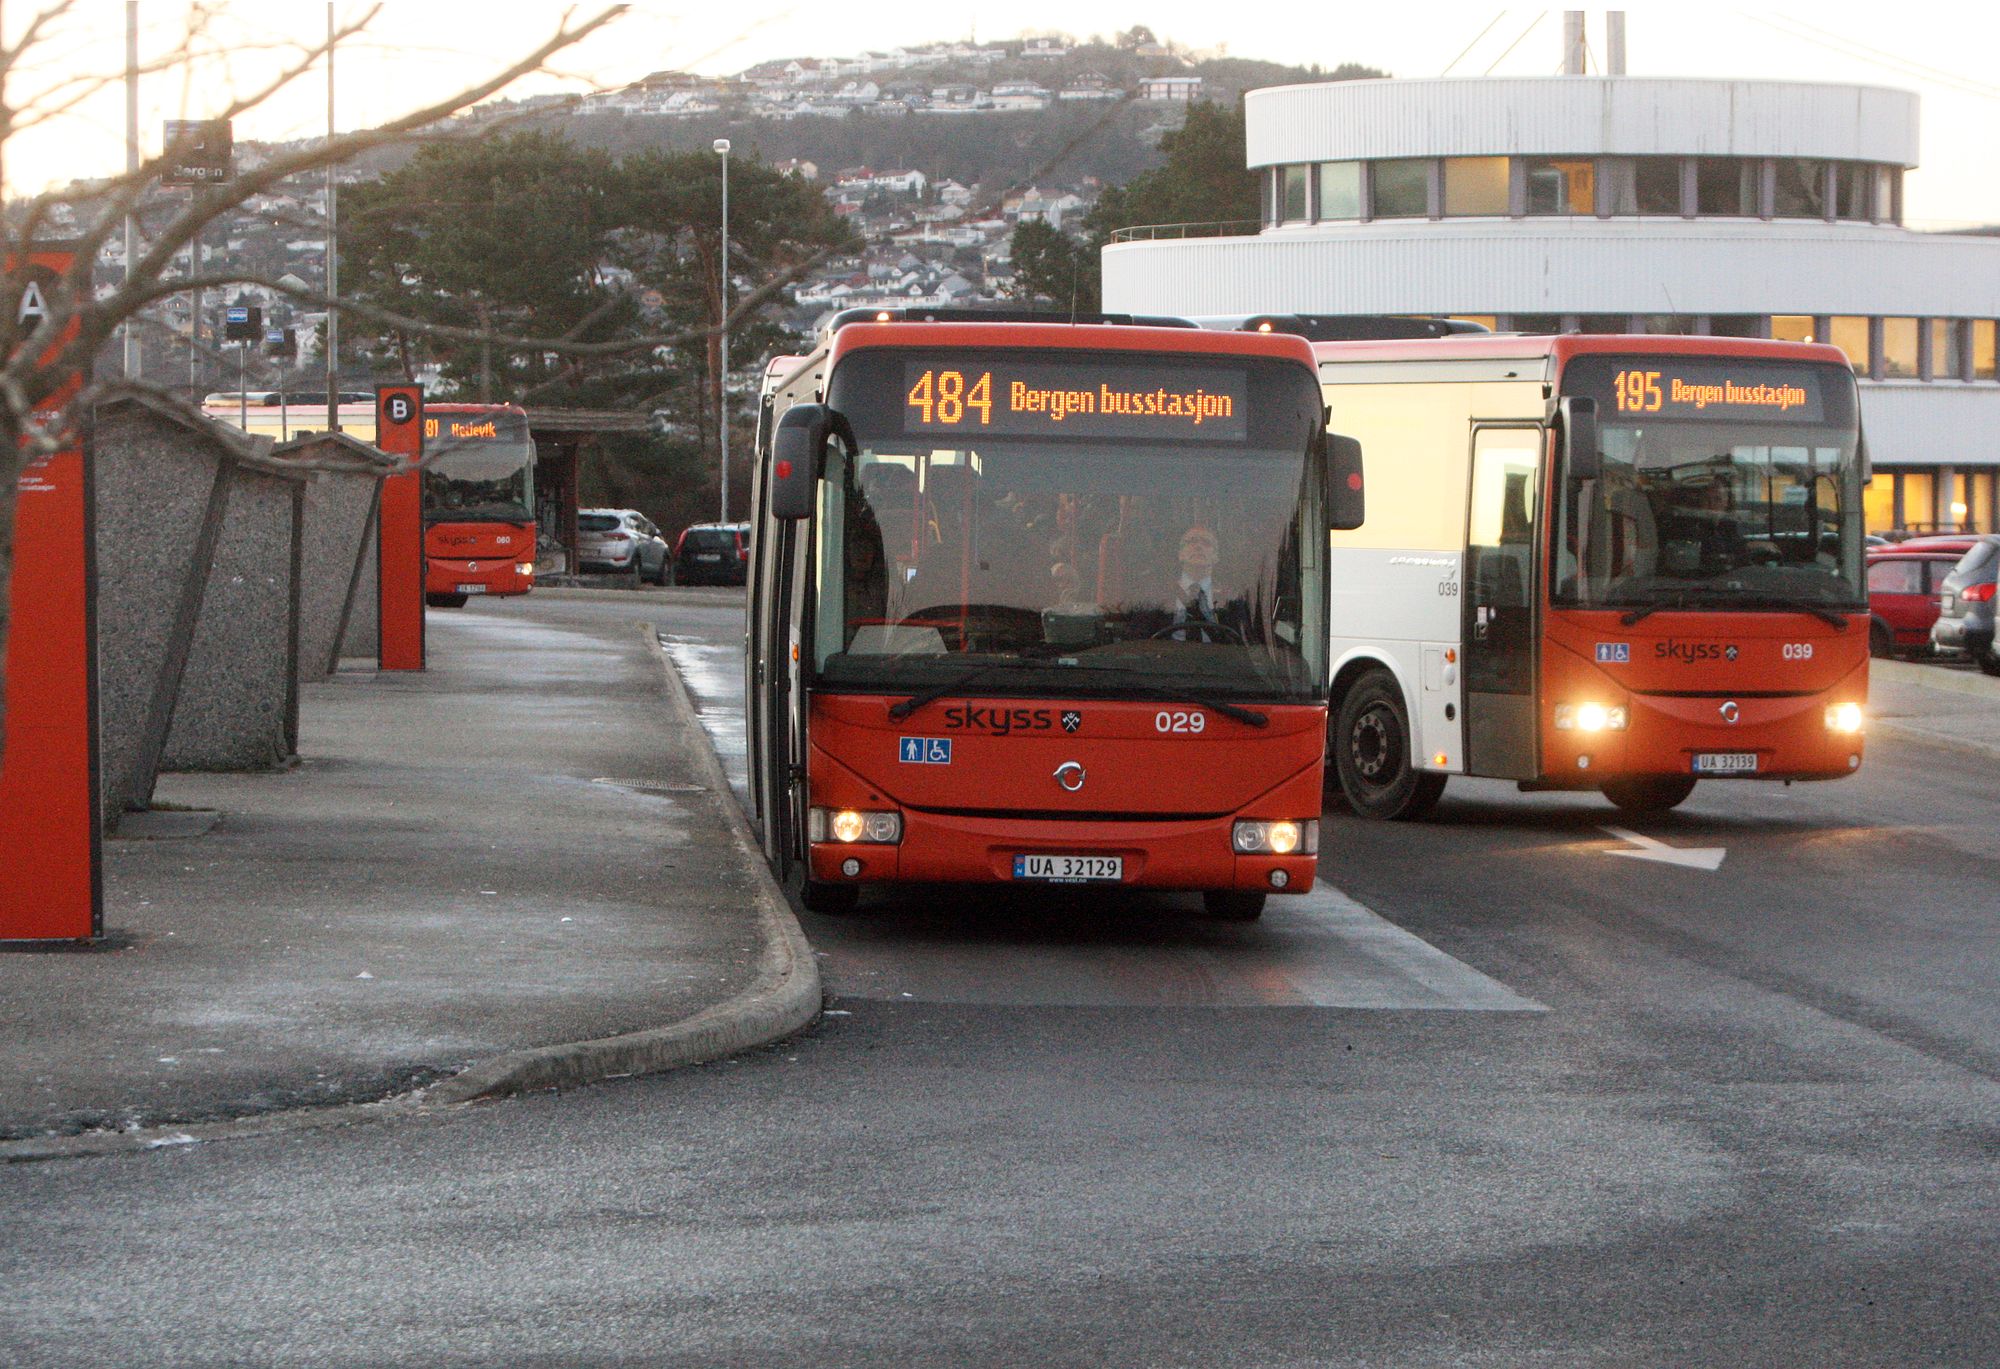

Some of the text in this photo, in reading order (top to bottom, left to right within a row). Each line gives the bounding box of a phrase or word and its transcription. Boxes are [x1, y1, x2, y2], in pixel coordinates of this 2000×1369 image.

[18, 280, 49, 325] A
[908, 370, 1232, 424] 484 Bergen busstasjon
[1614, 370, 1805, 412] 195 Bergen busstasjon
[392, 399, 408, 419] B
[1438, 582, 1458, 596] 039
[1655, 638, 1720, 664] skyss
[1782, 643, 1813, 660] 039
[944, 700, 1052, 736] skyss
[1155, 711, 1205, 733] 029
[1702, 755, 1754, 768] UA 32139
[1030, 858, 1117, 876] UA 32129
